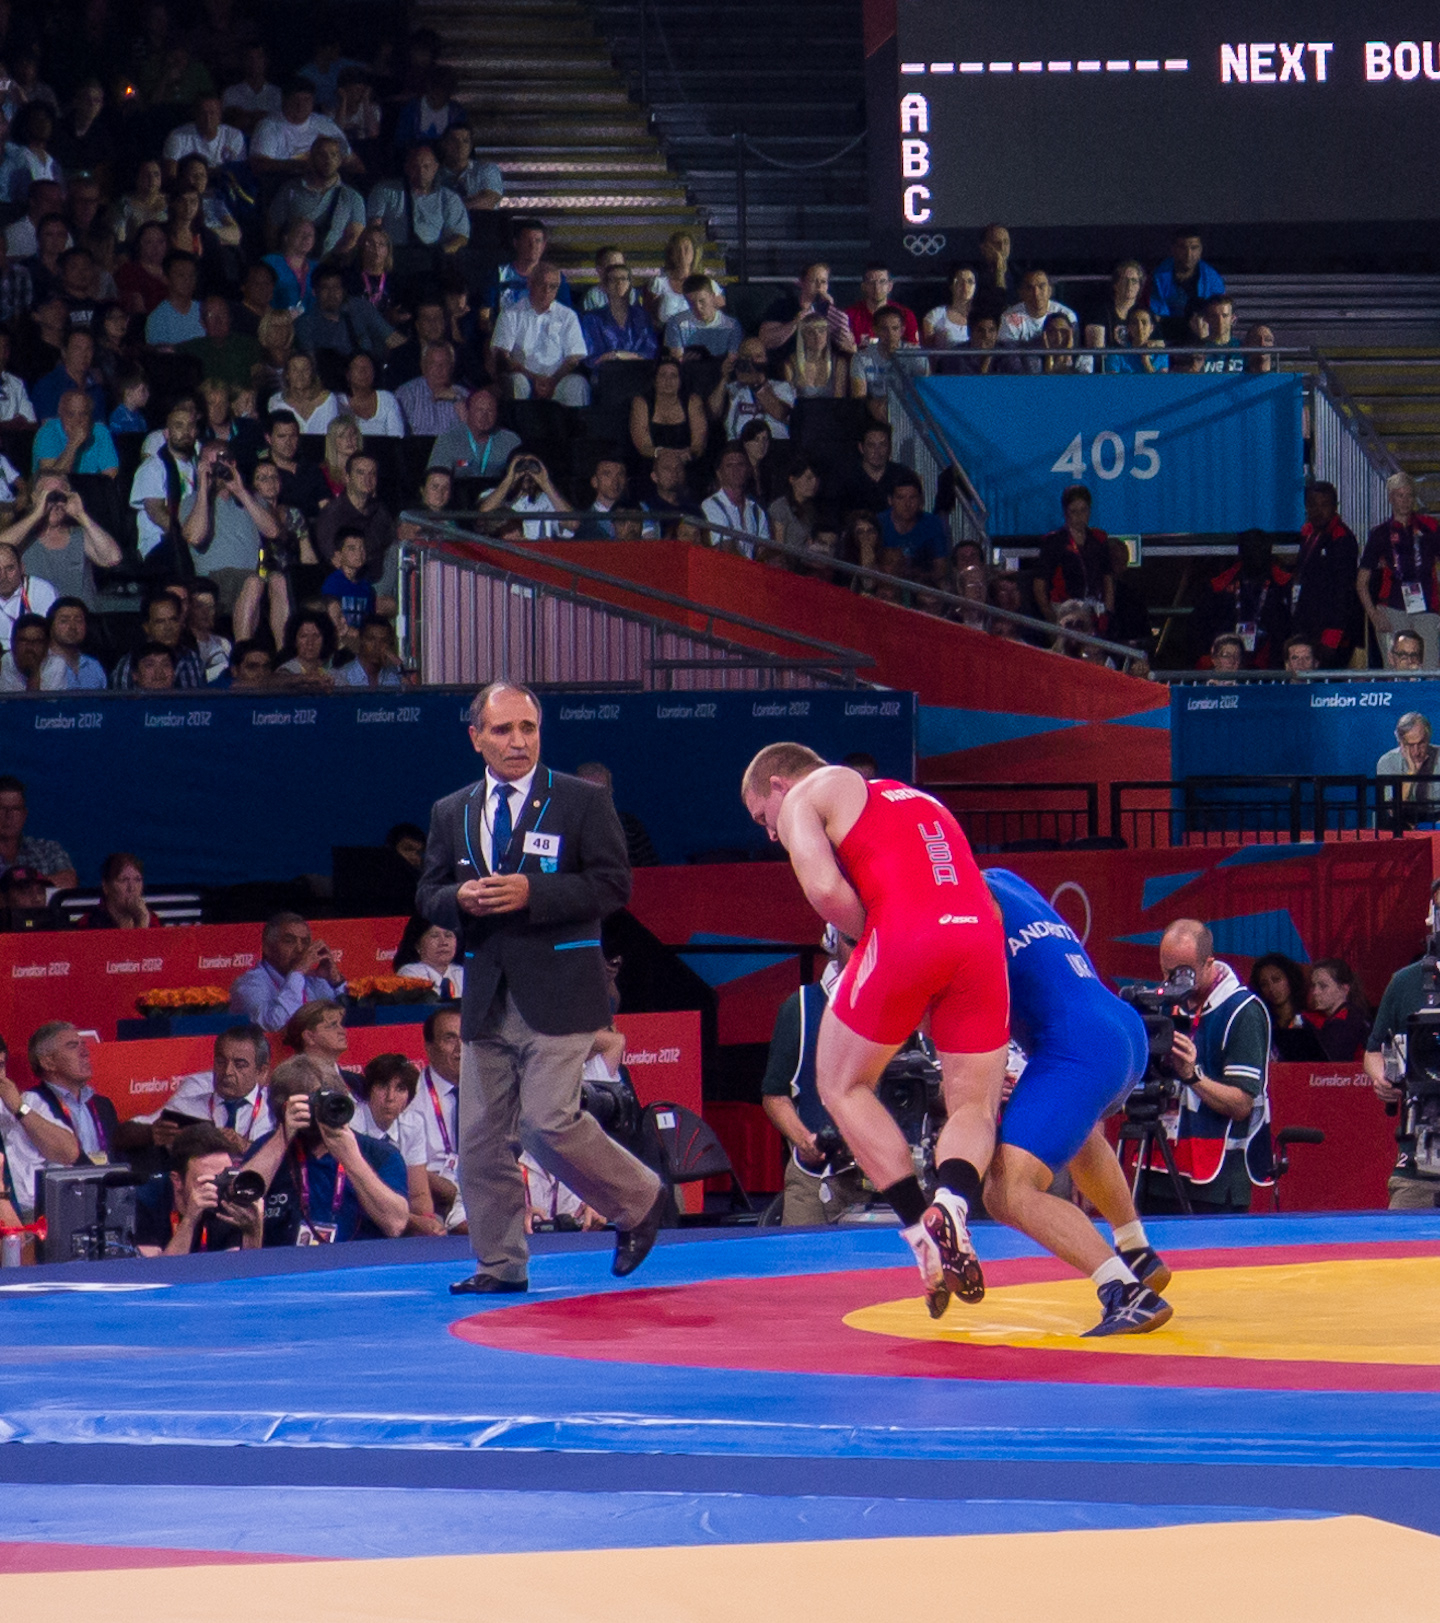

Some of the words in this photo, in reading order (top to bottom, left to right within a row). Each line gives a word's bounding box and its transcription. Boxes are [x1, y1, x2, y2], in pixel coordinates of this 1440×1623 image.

[1220, 43, 1333, 83] NEXT
[900, 92, 929, 133] A
[902, 139, 930, 179] B
[903, 184, 931, 224] C
[1050, 429, 1162, 480] 405
[1310, 694, 1357, 708] London
[1360, 692, 1392, 707] 2012
[357, 708, 395, 723] London
[560, 704, 596, 720] London
[657, 703, 693, 718] London
[752, 702, 787, 717] London
[844, 701, 878, 716] London
[35, 714, 76, 730] London
[145, 712, 185, 727] London
[252, 710, 291, 725] London
[533, 838, 550, 850] 48
[917, 820, 958, 886] USA
[107, 961, 140, 975] London
[199, 954, 232, 969] London
[12, 963, 47, 978] London
[622, 1051, 657, 1065] London
[658, 1049, 681, 1063] 2012
[130, 1077, 169, 1094] London
[1310, 1074, 1351, 1087] London
